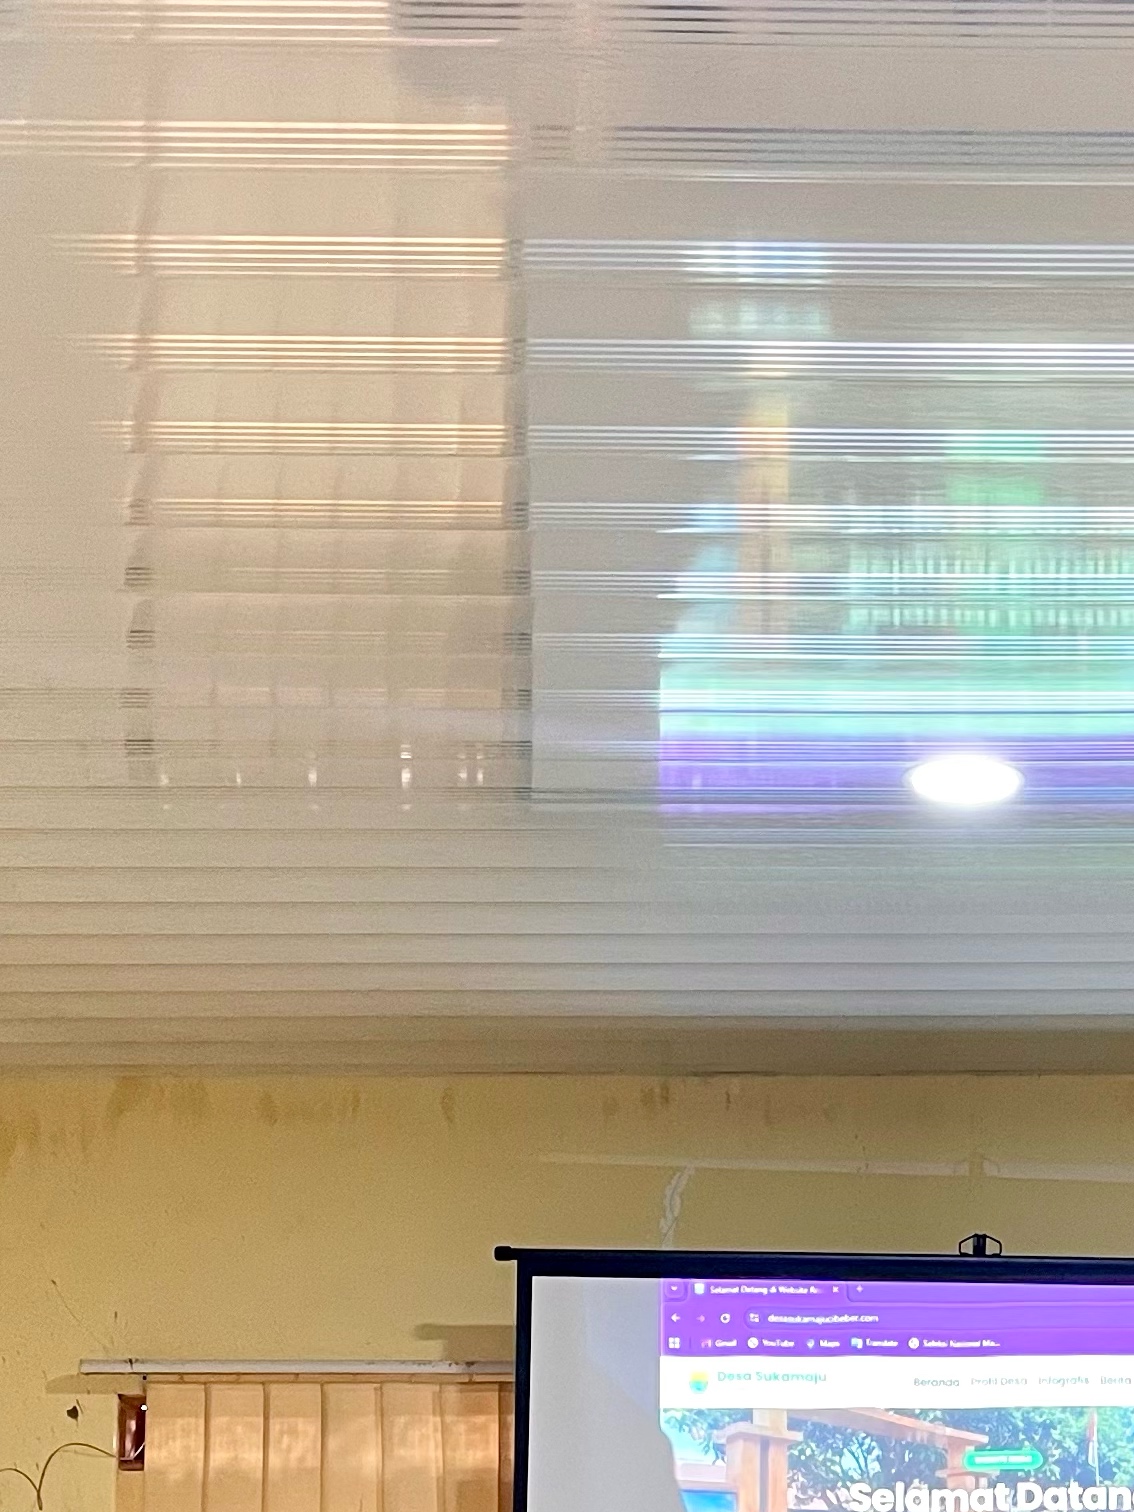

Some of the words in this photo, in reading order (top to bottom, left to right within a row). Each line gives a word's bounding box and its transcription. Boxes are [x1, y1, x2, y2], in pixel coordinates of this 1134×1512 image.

[717, 1371, 752, 1382] Desa
[755, 1371, 827, 1385] Sukamaju
[913, 1377, 960, 1387] Beranda
